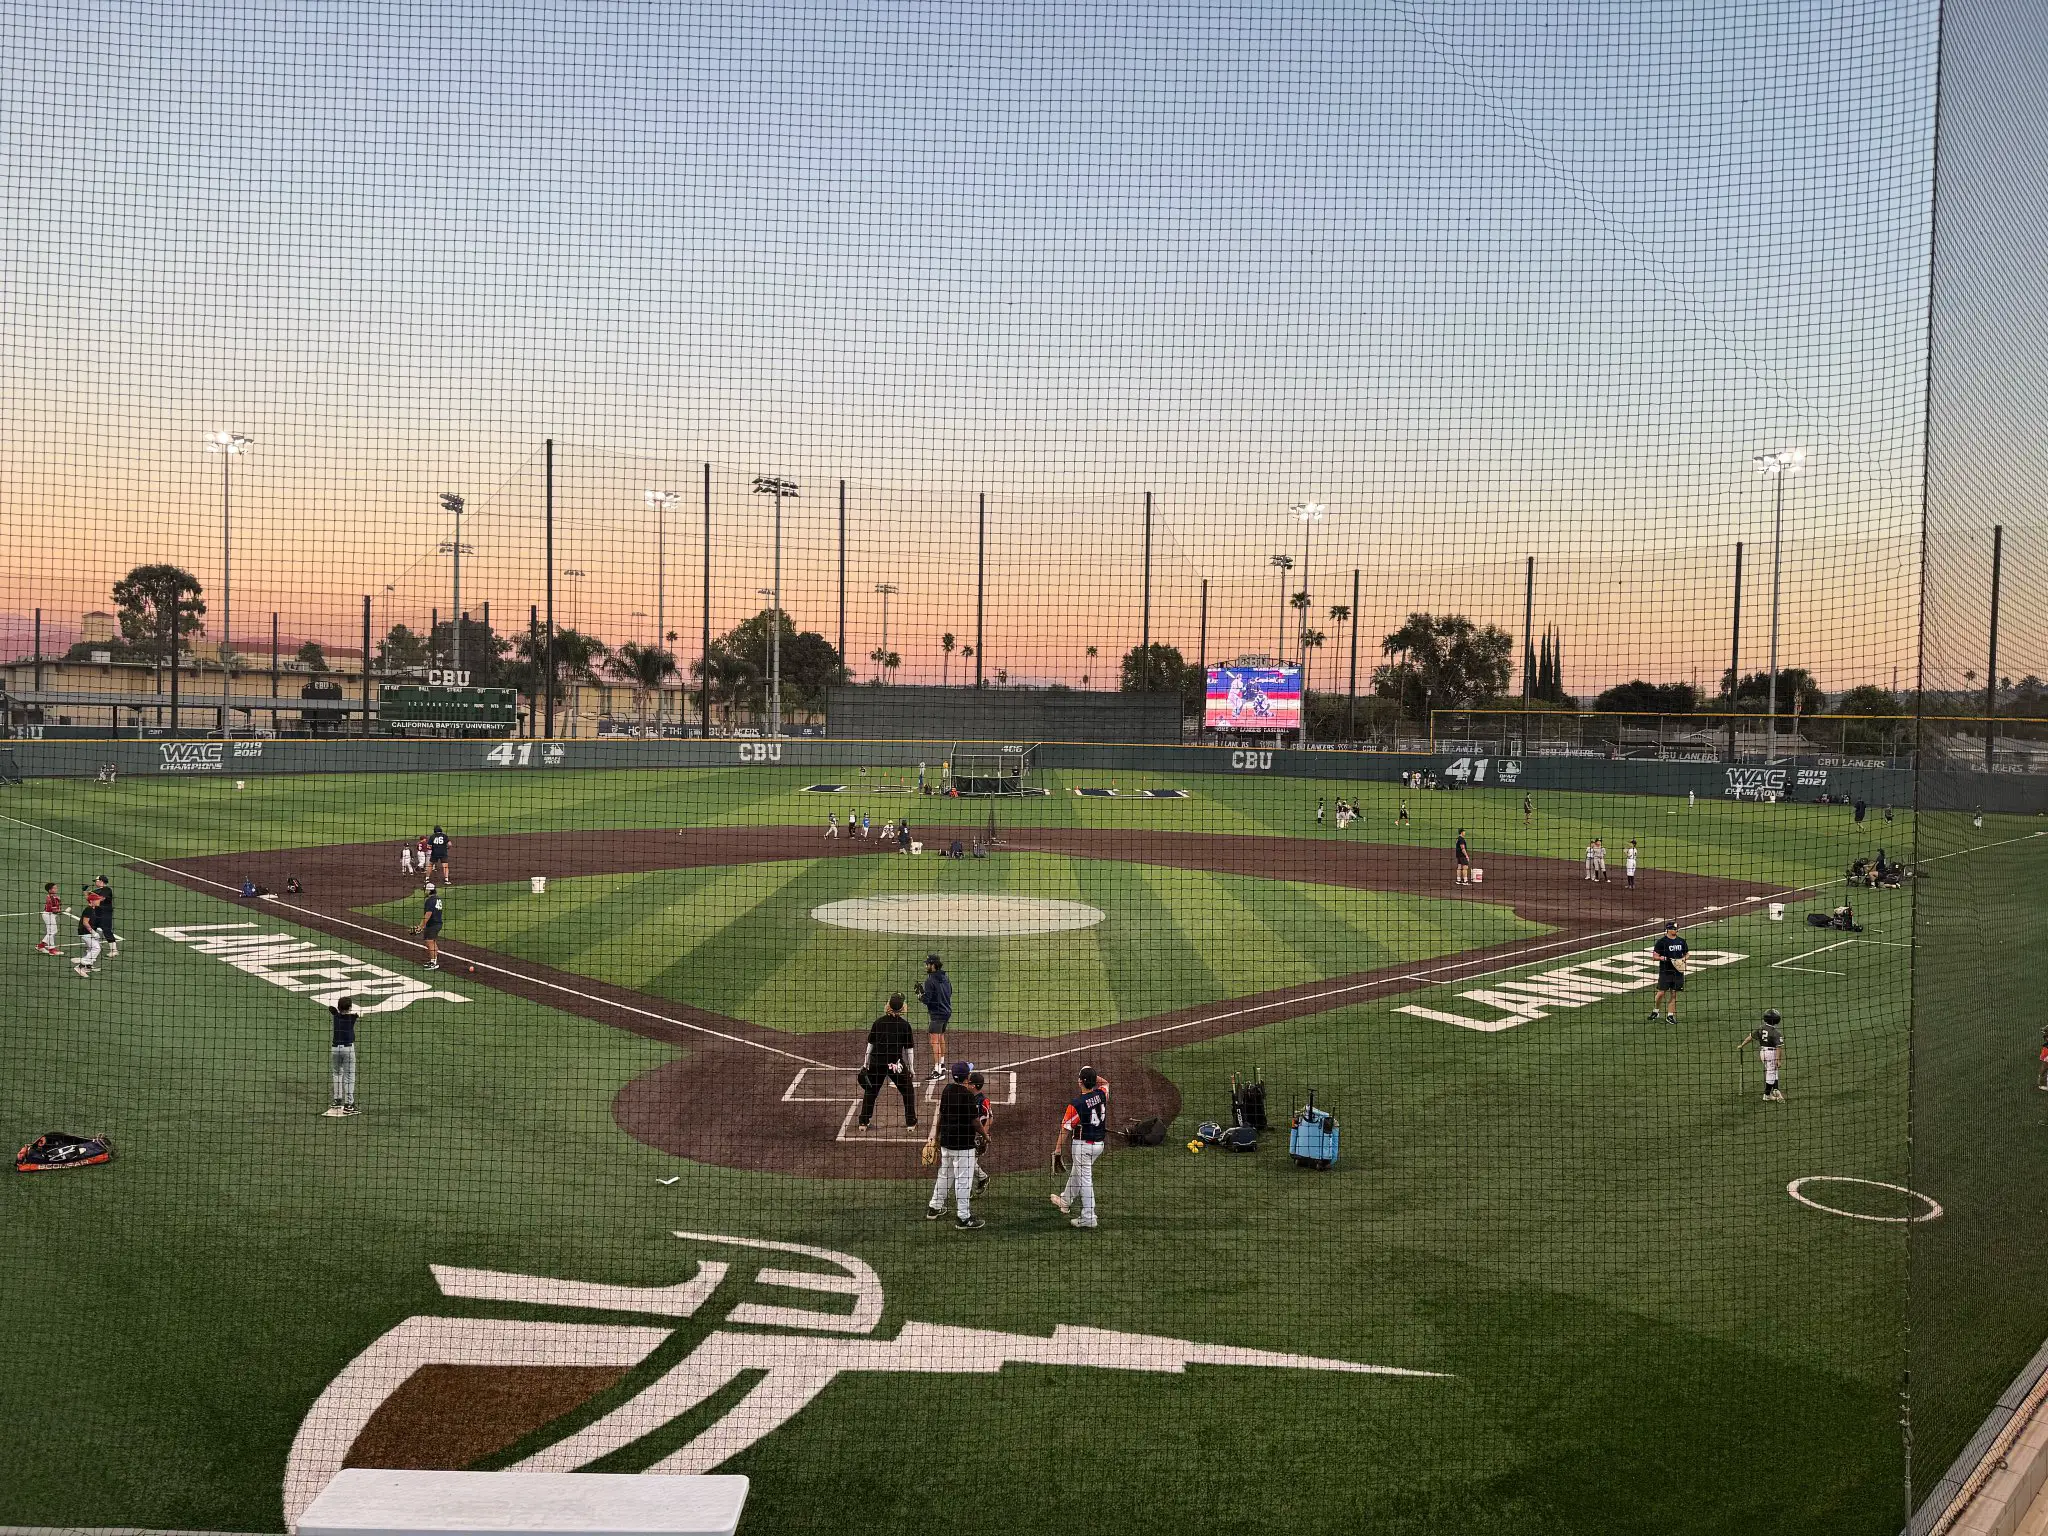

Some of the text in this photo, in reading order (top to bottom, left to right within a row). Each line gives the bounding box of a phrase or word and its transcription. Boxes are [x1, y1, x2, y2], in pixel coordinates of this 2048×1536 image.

[428, 669, 471, 687] CBU
[391, 721, 435, 729] CALIFORNIA
[465, 723, 506, 731] UNIVERSITY
[233, 741, 263, 749] 2019
[159, 742, 224, 763] WAC
[233, 749, 263, 757] 2021
[486, 742, 533, 765] 41
[739, 743, 782, 761] CBU
[1231, 751, 1273, 770] CBU
[1817, 758, 1887, 769] CBU LANCERS
[159, 762, 224, 771] CHAMPIONS
[1444, 757, 1489, 782] 41
[1725, 767, 1787, 790] WAC
[1796, 769, 1828, 778] 2019
[1796, 777, 1827, 786] 2021
[433, 836, 444, 845] 46
